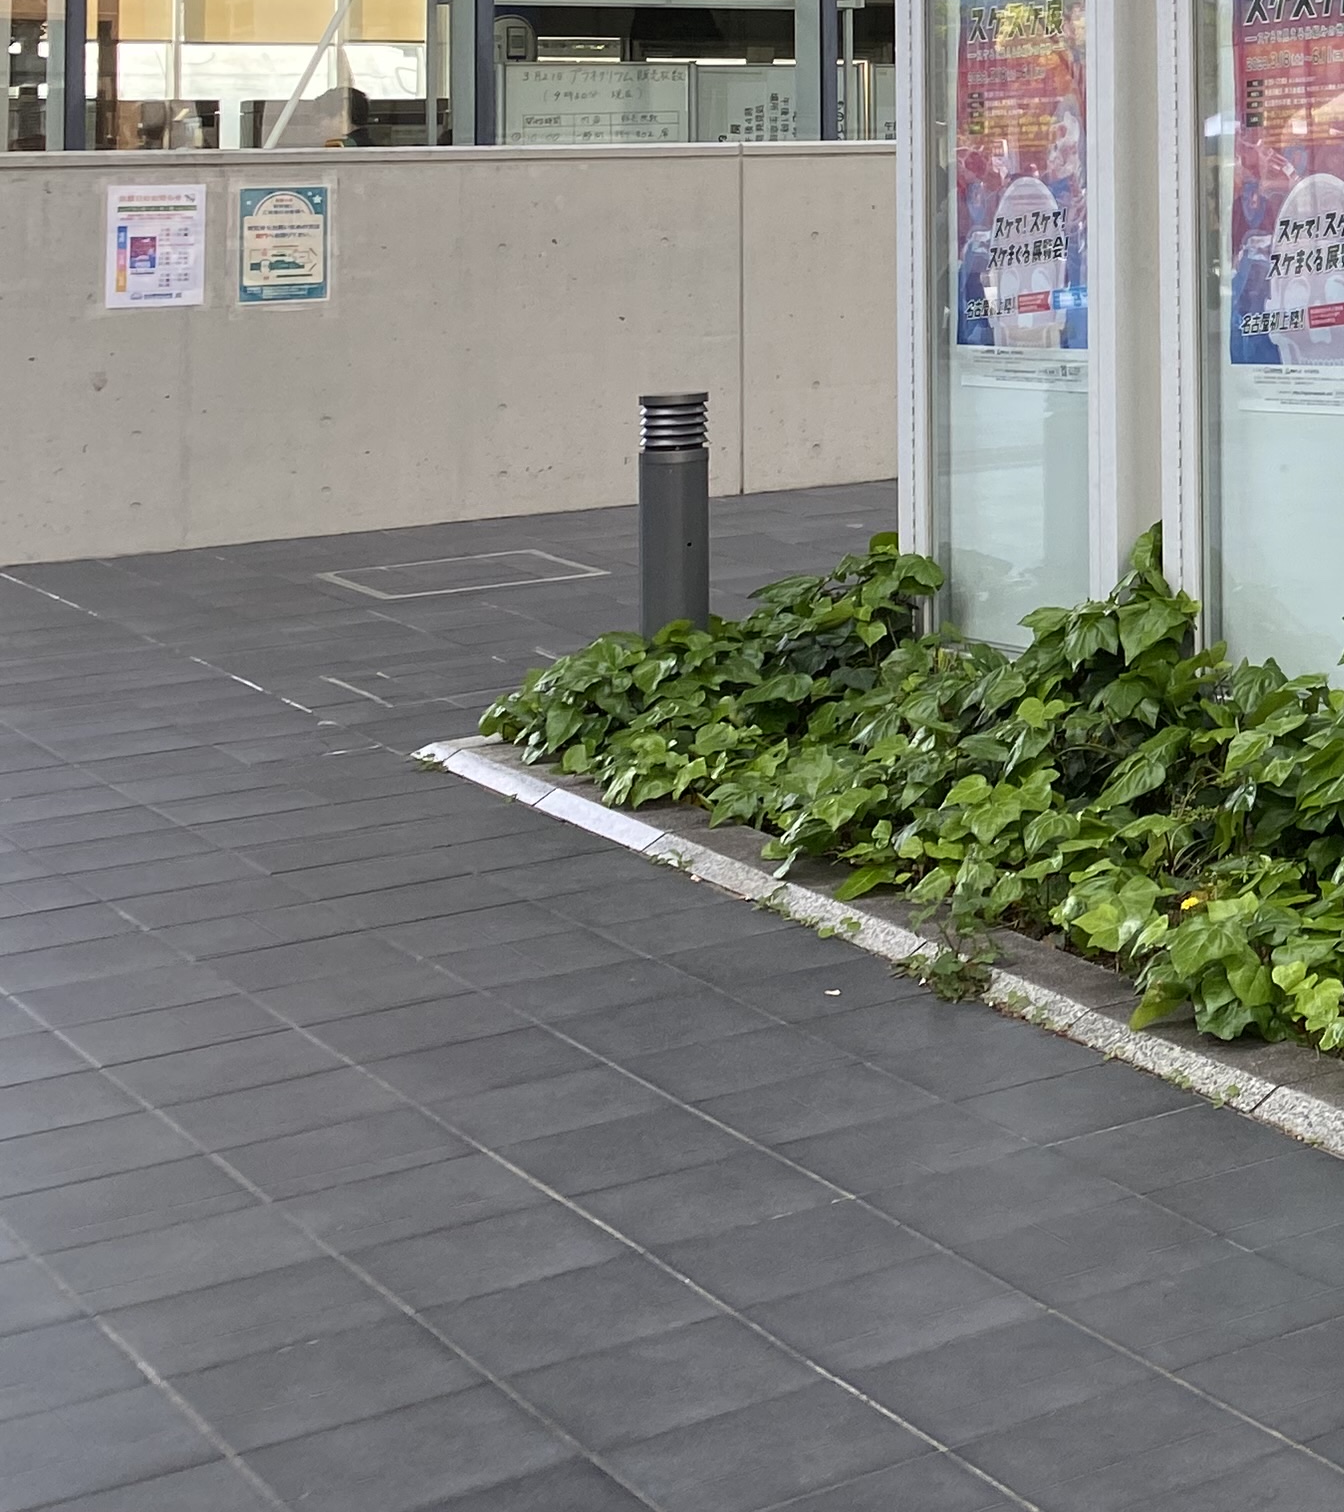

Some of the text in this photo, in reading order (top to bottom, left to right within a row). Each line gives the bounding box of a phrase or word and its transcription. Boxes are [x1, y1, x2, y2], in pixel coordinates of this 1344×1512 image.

[1241, 308, 1306, 336] 名古屋初上陸!
